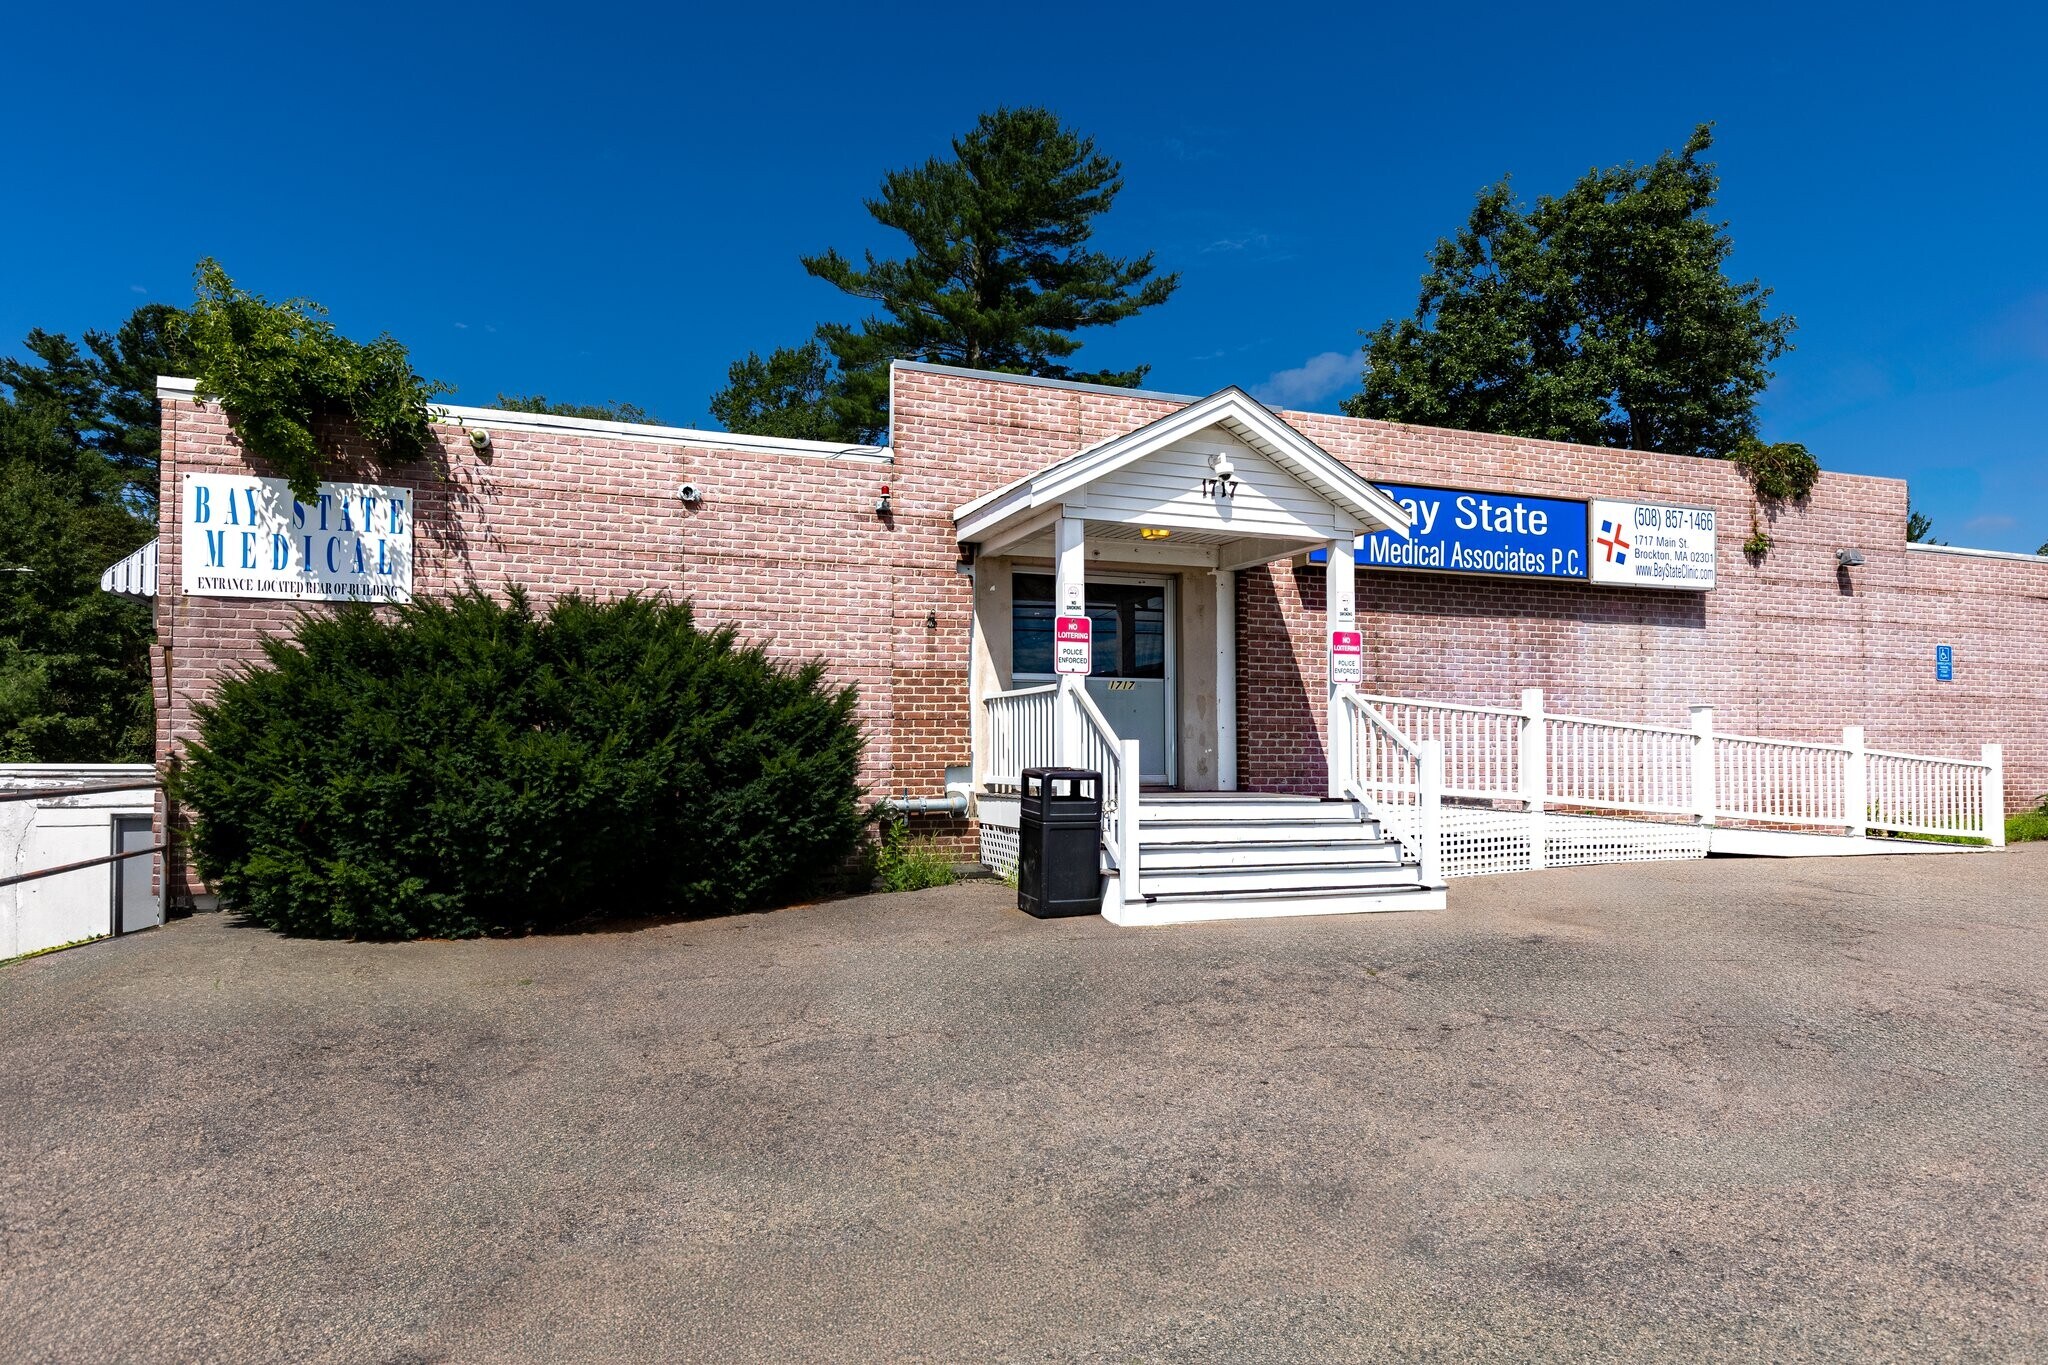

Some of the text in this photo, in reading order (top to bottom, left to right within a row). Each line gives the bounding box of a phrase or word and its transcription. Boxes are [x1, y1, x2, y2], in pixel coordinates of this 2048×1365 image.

[1202, 479, 1239, 498] 1717
[194, 486, 404, 534] BAY STATE
[1455, 495, 1548, 536] State
[1634, 507, 1713, 531] (508) 857-1466
[1634, 535, 1689, 549] 1717 Main St.
[205, 529, 393, 575] MEDICAL
[1370, 534, 1584, 576] Medical Associates P.C.
[1634, 548, 1714, 563] Brockton, MA 02301
[1635, 562, 1714, 580] www.BayStateClinic.com
[198, 577, 398, 597] ENTRANCE LOCATED REAR OF BUILDING
[1057, 632, 1089, 640] LOITERING
[1058, 657, 1088, 665] ENFORCED
[1110, 681, 1136, 690] 1717
